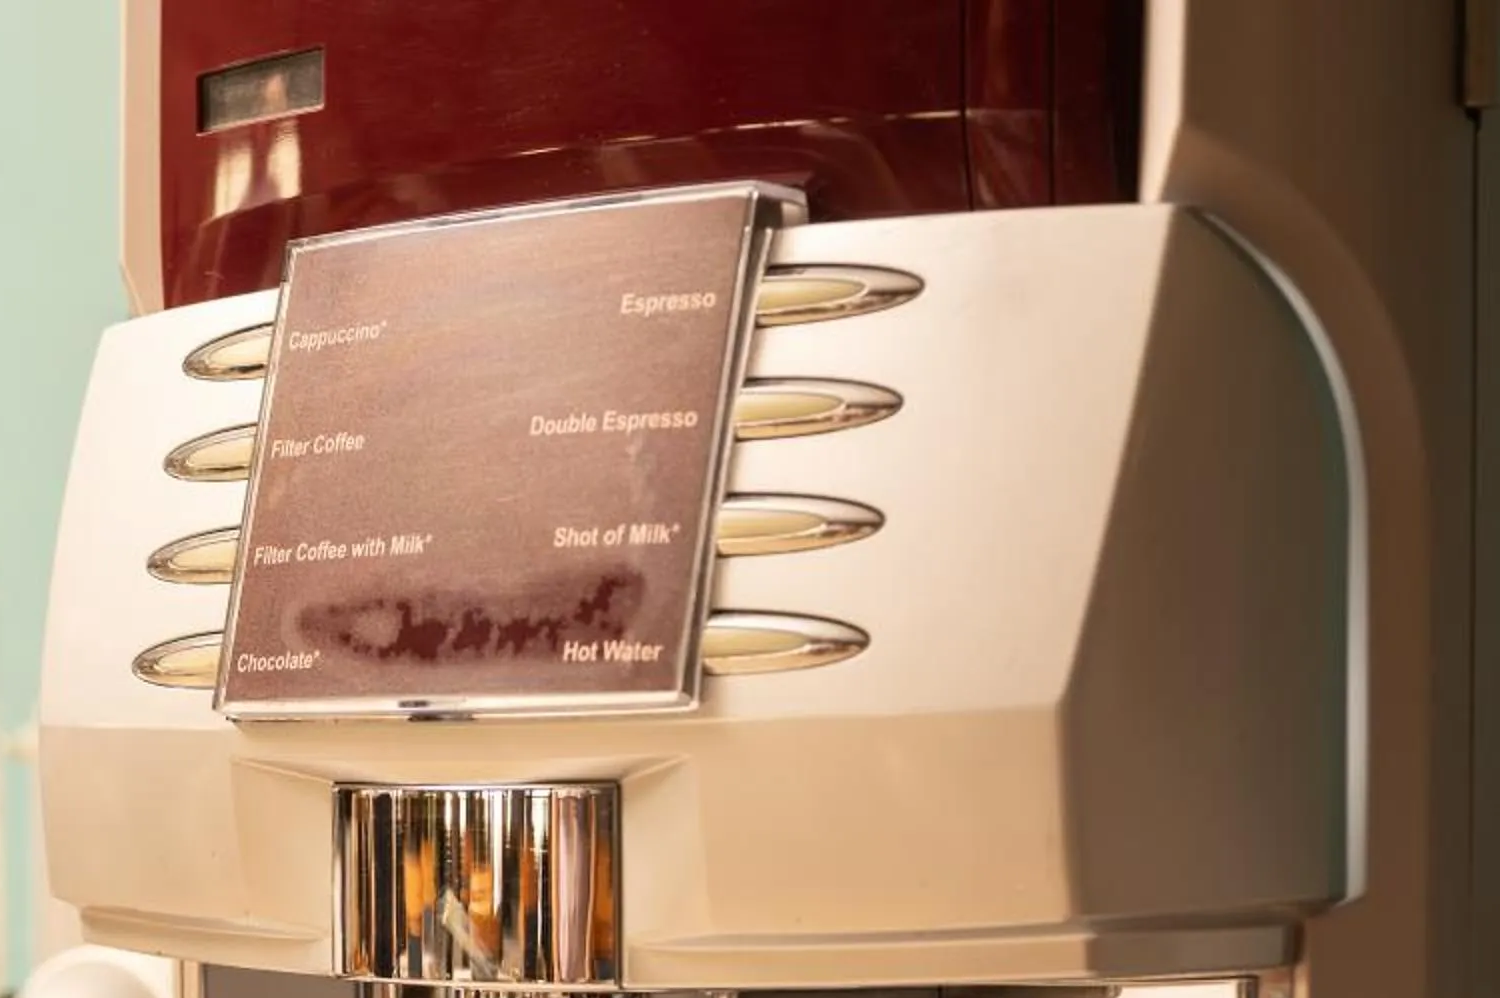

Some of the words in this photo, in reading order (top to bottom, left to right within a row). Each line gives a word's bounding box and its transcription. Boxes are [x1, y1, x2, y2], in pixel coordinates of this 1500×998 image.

[621, 291, 716, 316] Espresso
[530, 414, 597, 435] Double
[602, 411, 697, 434] Espresso
[271, 439, 311, 458] Filter
[313, 434, 365, 454] Coffee
[553, 526, 598, 547] Shot
[603, 525, 625, 545] of
[253, 546, 292, 565] Filter
[296, 541, 347, 561] Coffee
[351, 538, 386, 557] with
[563, 642, 594, 663] Hot
[605, 640, 663, 662] Water
